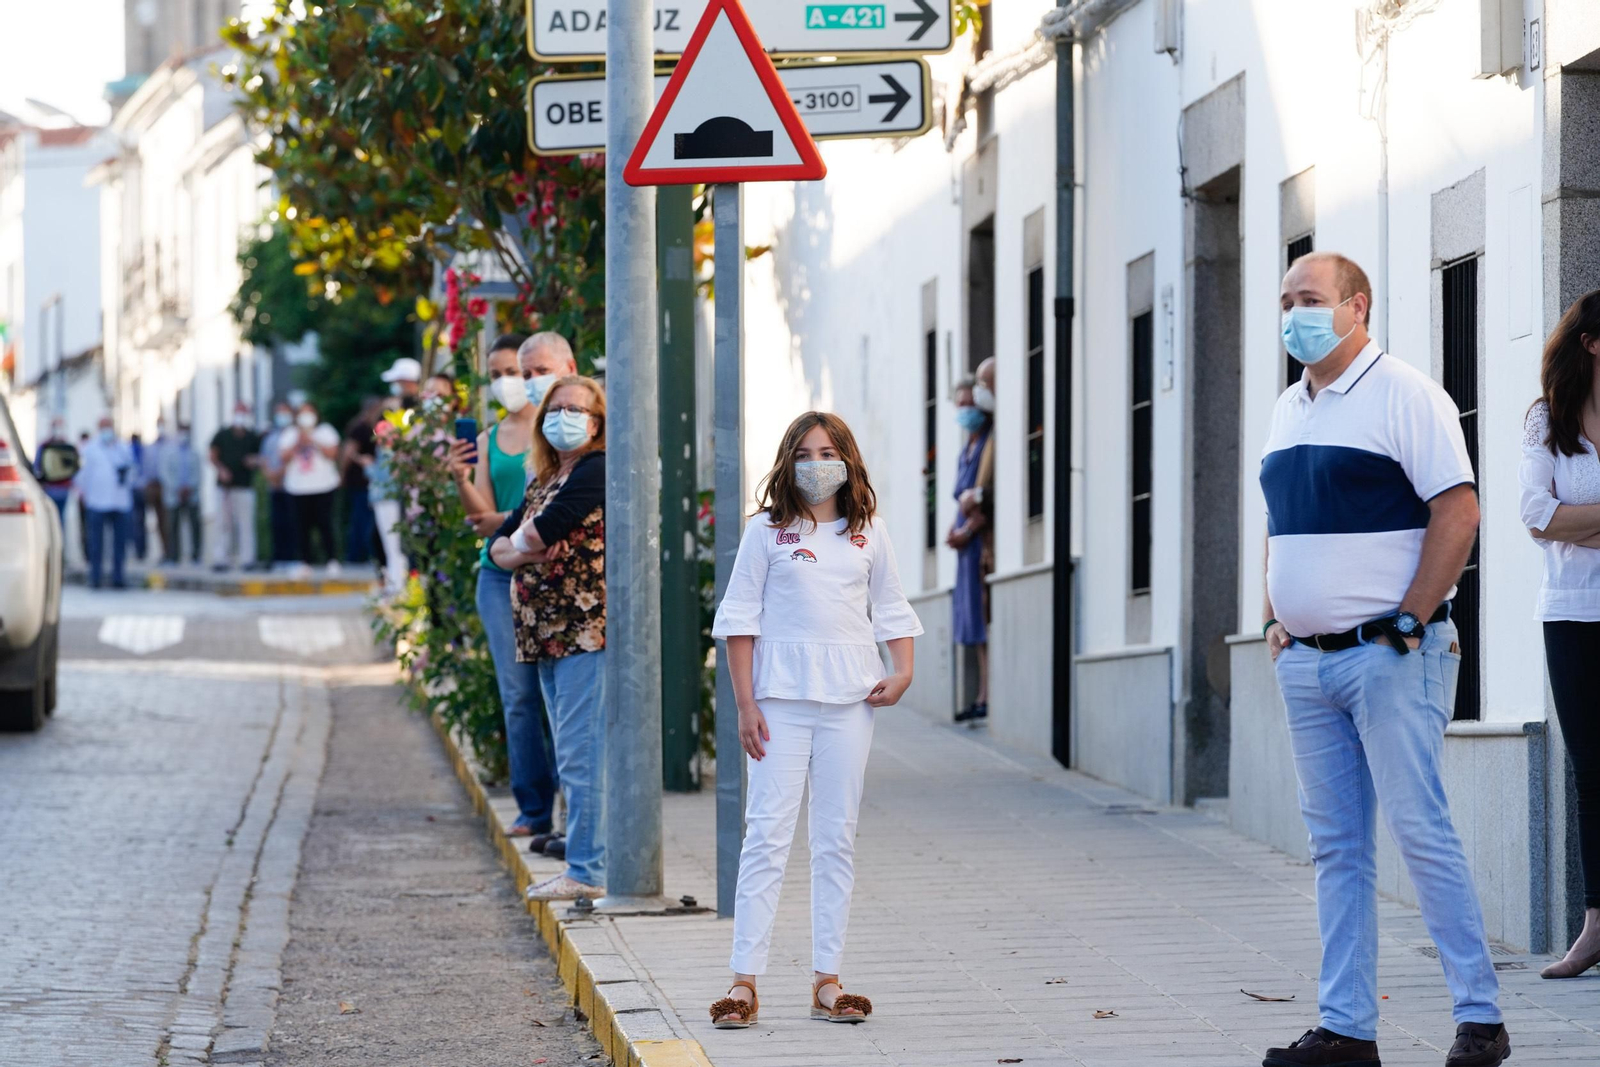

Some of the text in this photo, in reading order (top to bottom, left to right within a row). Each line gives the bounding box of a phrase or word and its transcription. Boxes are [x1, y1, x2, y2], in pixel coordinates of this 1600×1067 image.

[808, 7, 883, 27] A-421
[546, 91, 854, 124] OBE -3100
